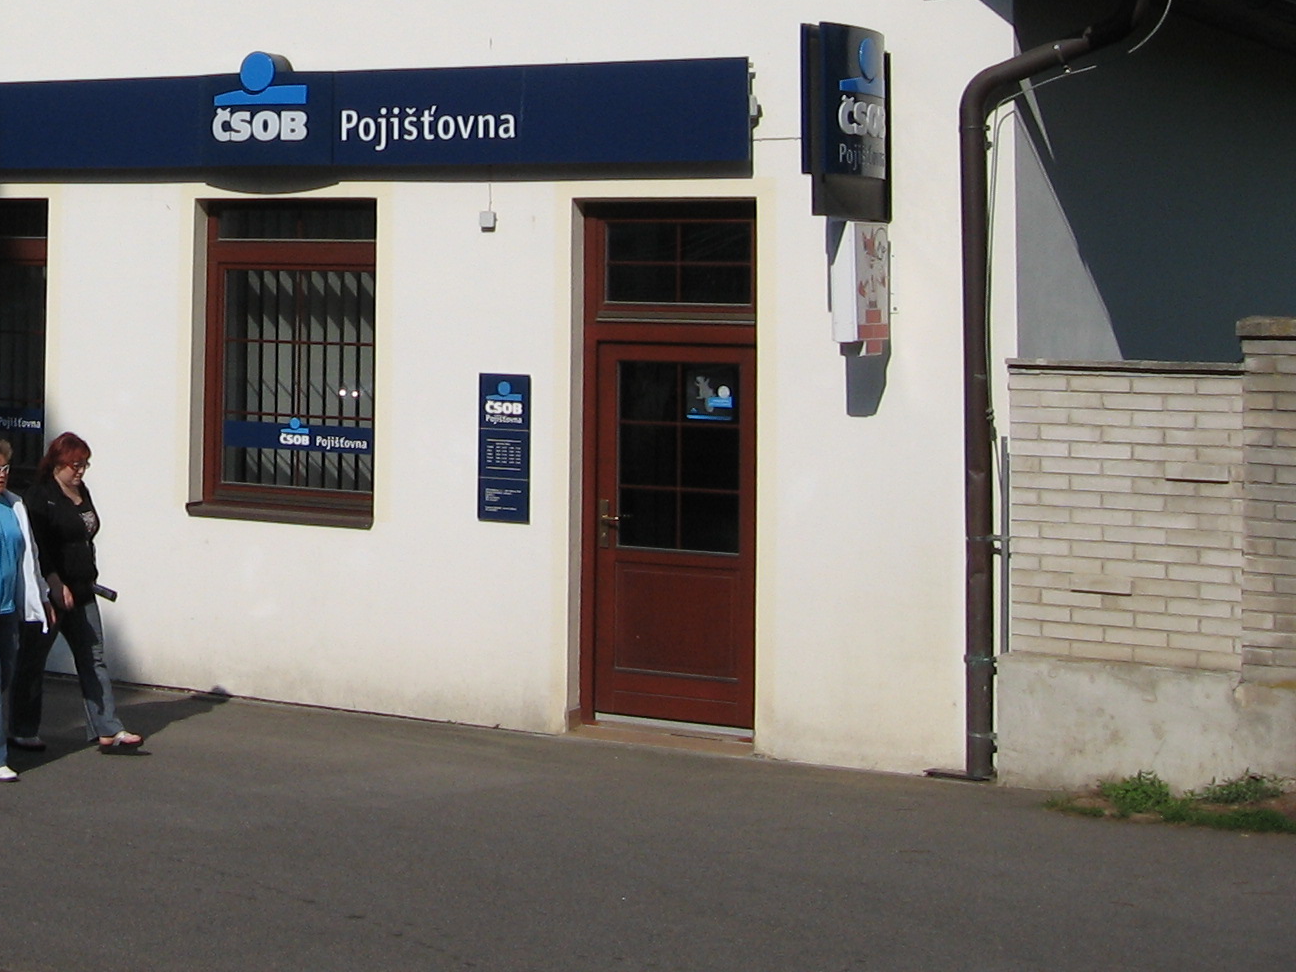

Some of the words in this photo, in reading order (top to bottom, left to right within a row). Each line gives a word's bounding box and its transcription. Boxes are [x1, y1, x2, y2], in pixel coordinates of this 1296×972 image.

[212, 107, 308, 142] ČSOB
[340, 105, 516, 151] Pojišťovna
[485, 400, 523, 415] ČSOB
[280, 432, 310, 446] ČSOB
[316, 435, 368, 450] Pojišťovna
